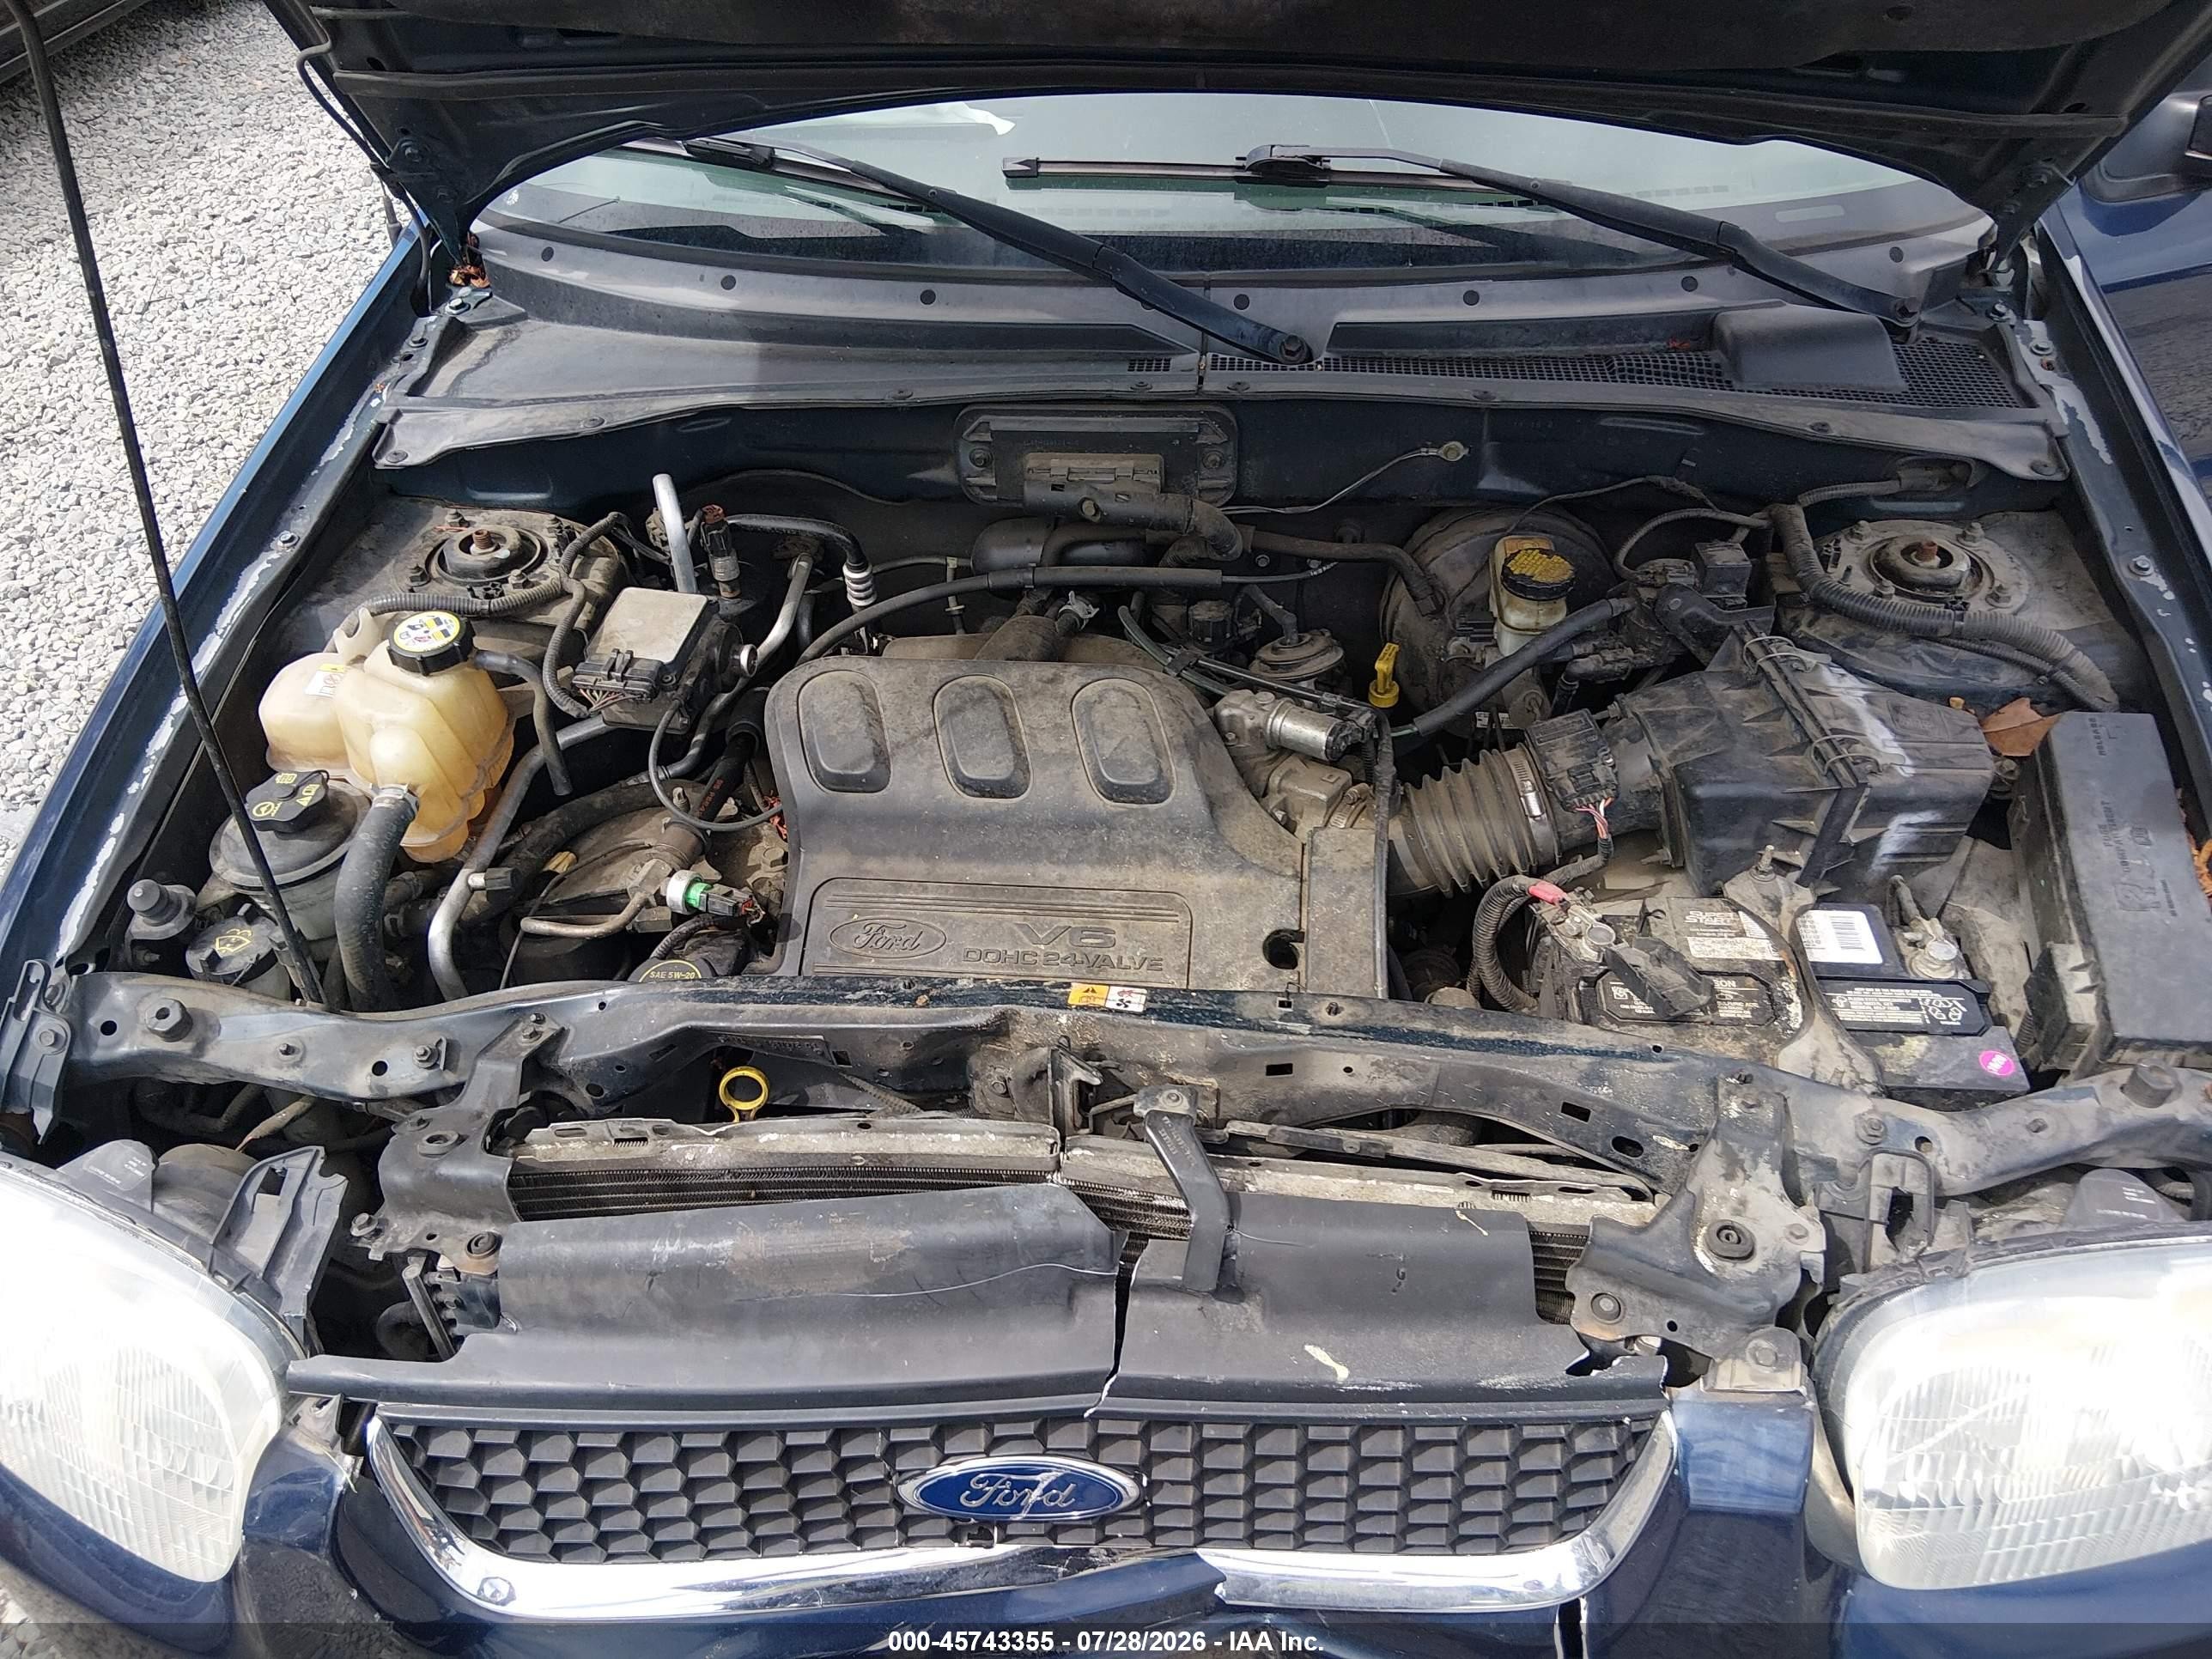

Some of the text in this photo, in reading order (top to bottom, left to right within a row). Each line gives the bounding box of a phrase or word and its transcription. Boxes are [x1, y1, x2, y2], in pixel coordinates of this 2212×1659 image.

[853, 922, 923, 951] Ford
[1013, 922, 1116, 948] V6
[963, 948, 1163, 971] DOHC 24-VALVE
[959, 1472, 1076, 1508] Ford
